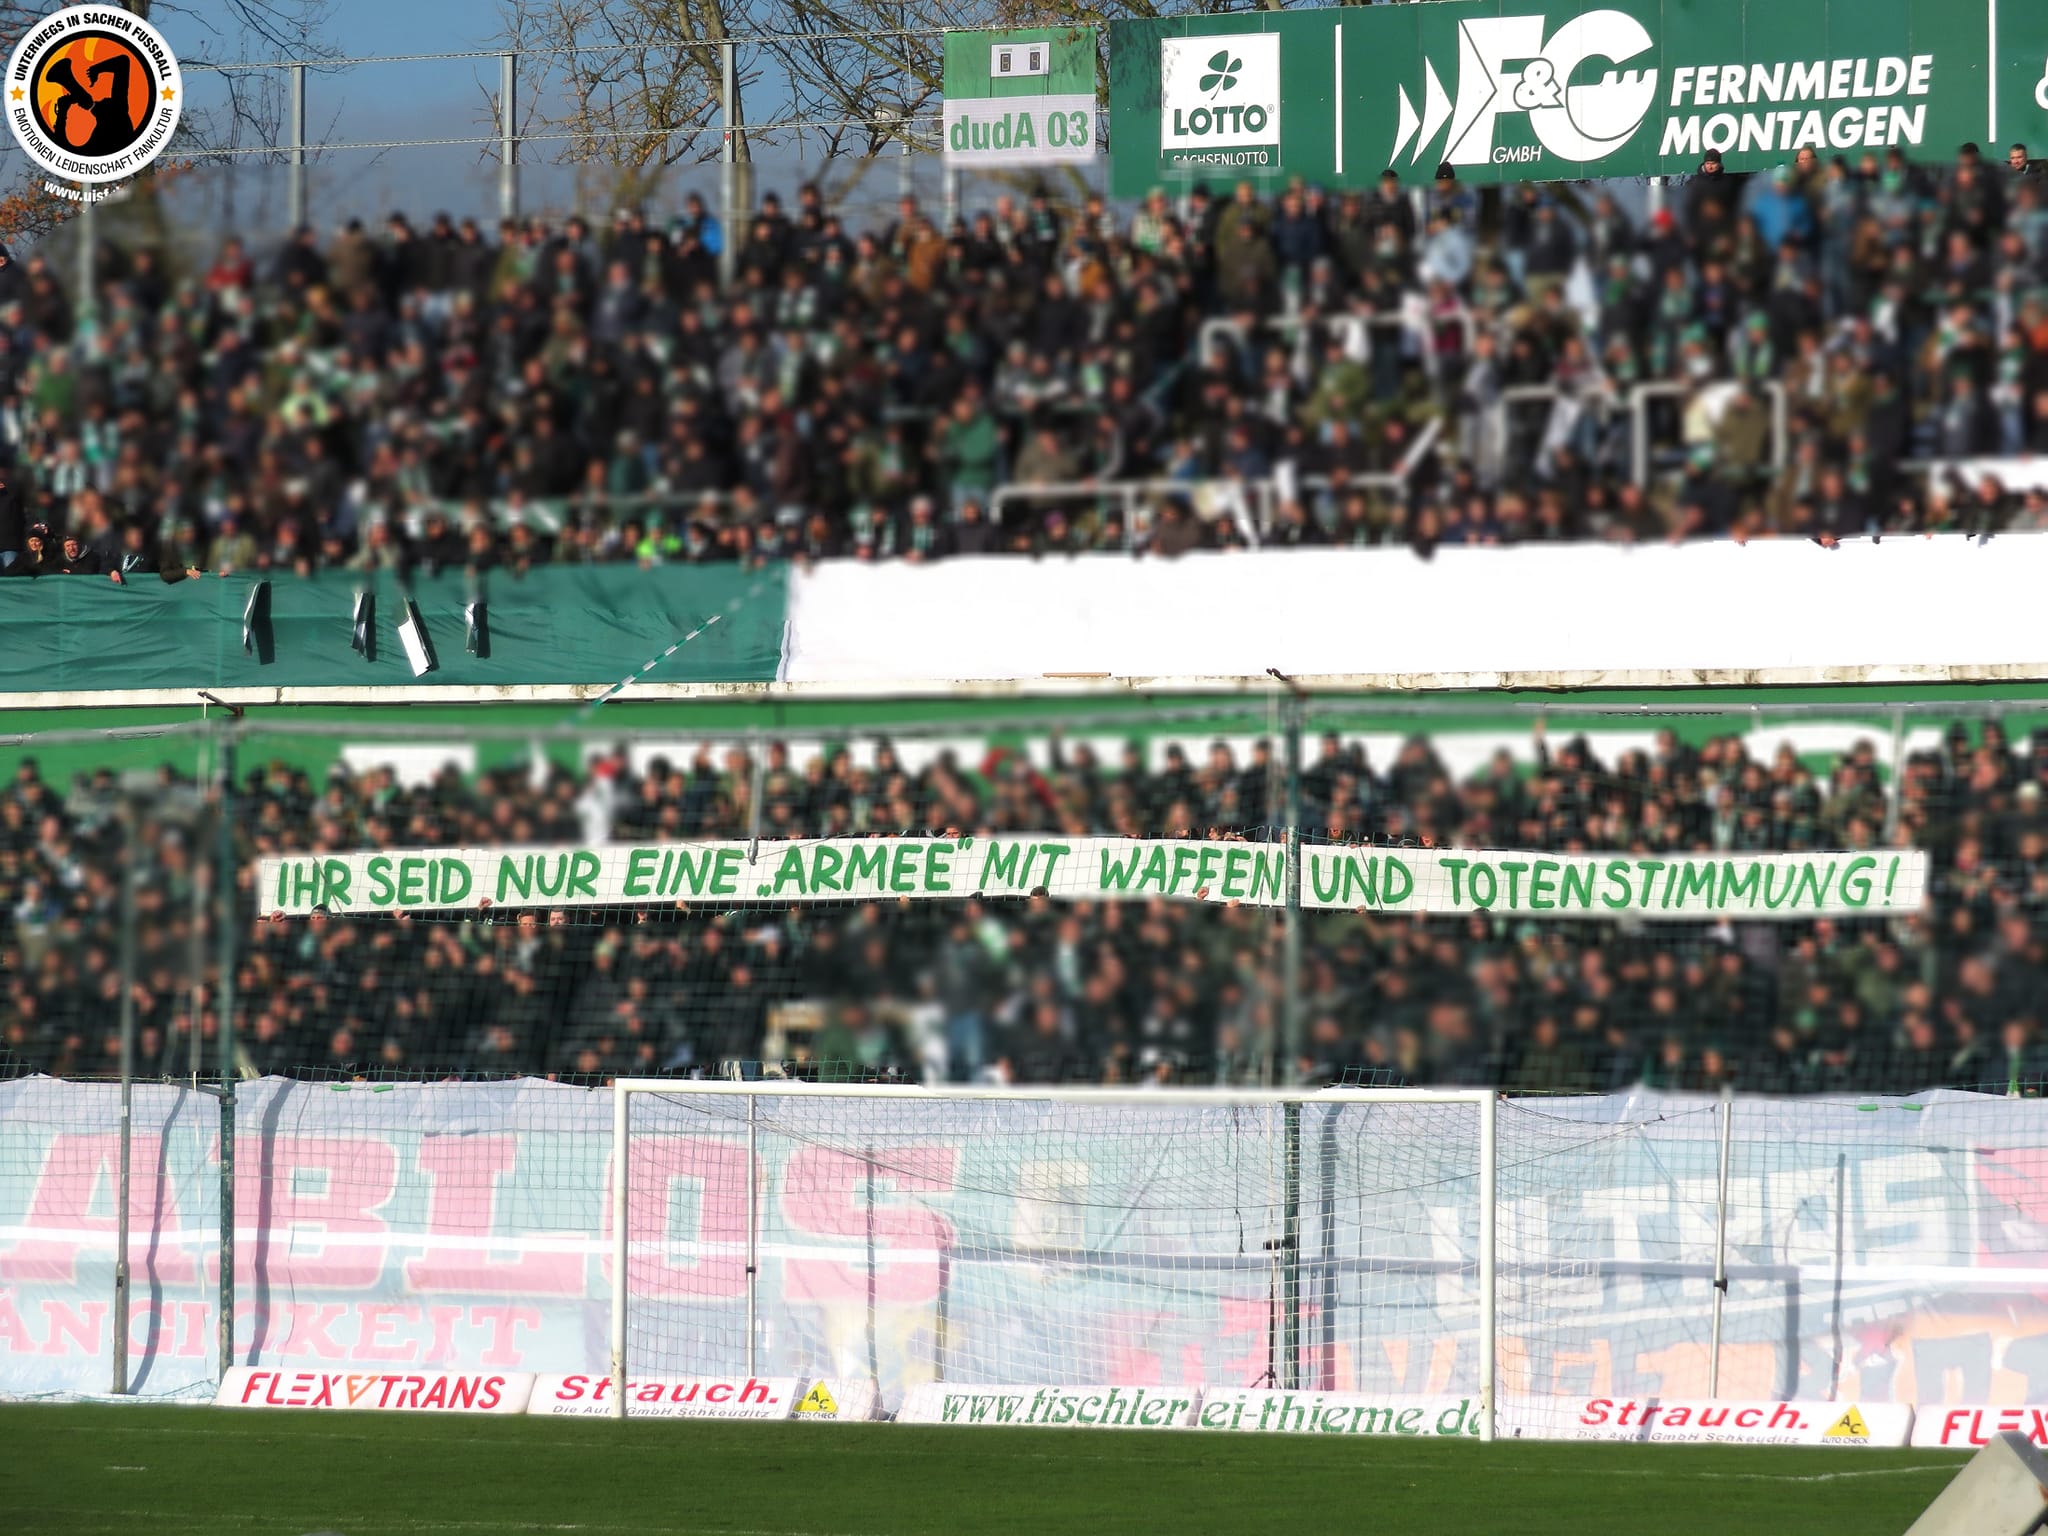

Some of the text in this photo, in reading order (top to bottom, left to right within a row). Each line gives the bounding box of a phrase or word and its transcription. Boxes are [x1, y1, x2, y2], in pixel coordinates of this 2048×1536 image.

[1670, 54, 1933, 107] FERNMELDE
[1047, 111, 1089, 147] 03
[1659, 104, 1927, 156] MONTAGEN
[1492, 145, 1542, 164] GMBH
[277, 858, 353, 907] IHR
[367, 856, 473, 905] SEID
[496, 851, 603, 902] NUR
[623, 848, 745, 896] EINE
[980, 841, 1071, 891] MIT
[1100, 846, 1286, 900] WAFFEN
[1311, 854, 1414, 905] UND
[1439, 855, 1902, 909] TOTENSTIMMUNG!
[555, 1374, 778, 1405] Stauch.
[583, 1406, 611, 1416] Aut
[1579, 1398, 1810, 1430] Strauch.
[1651, 1432, 1701, 1442] GmbH
